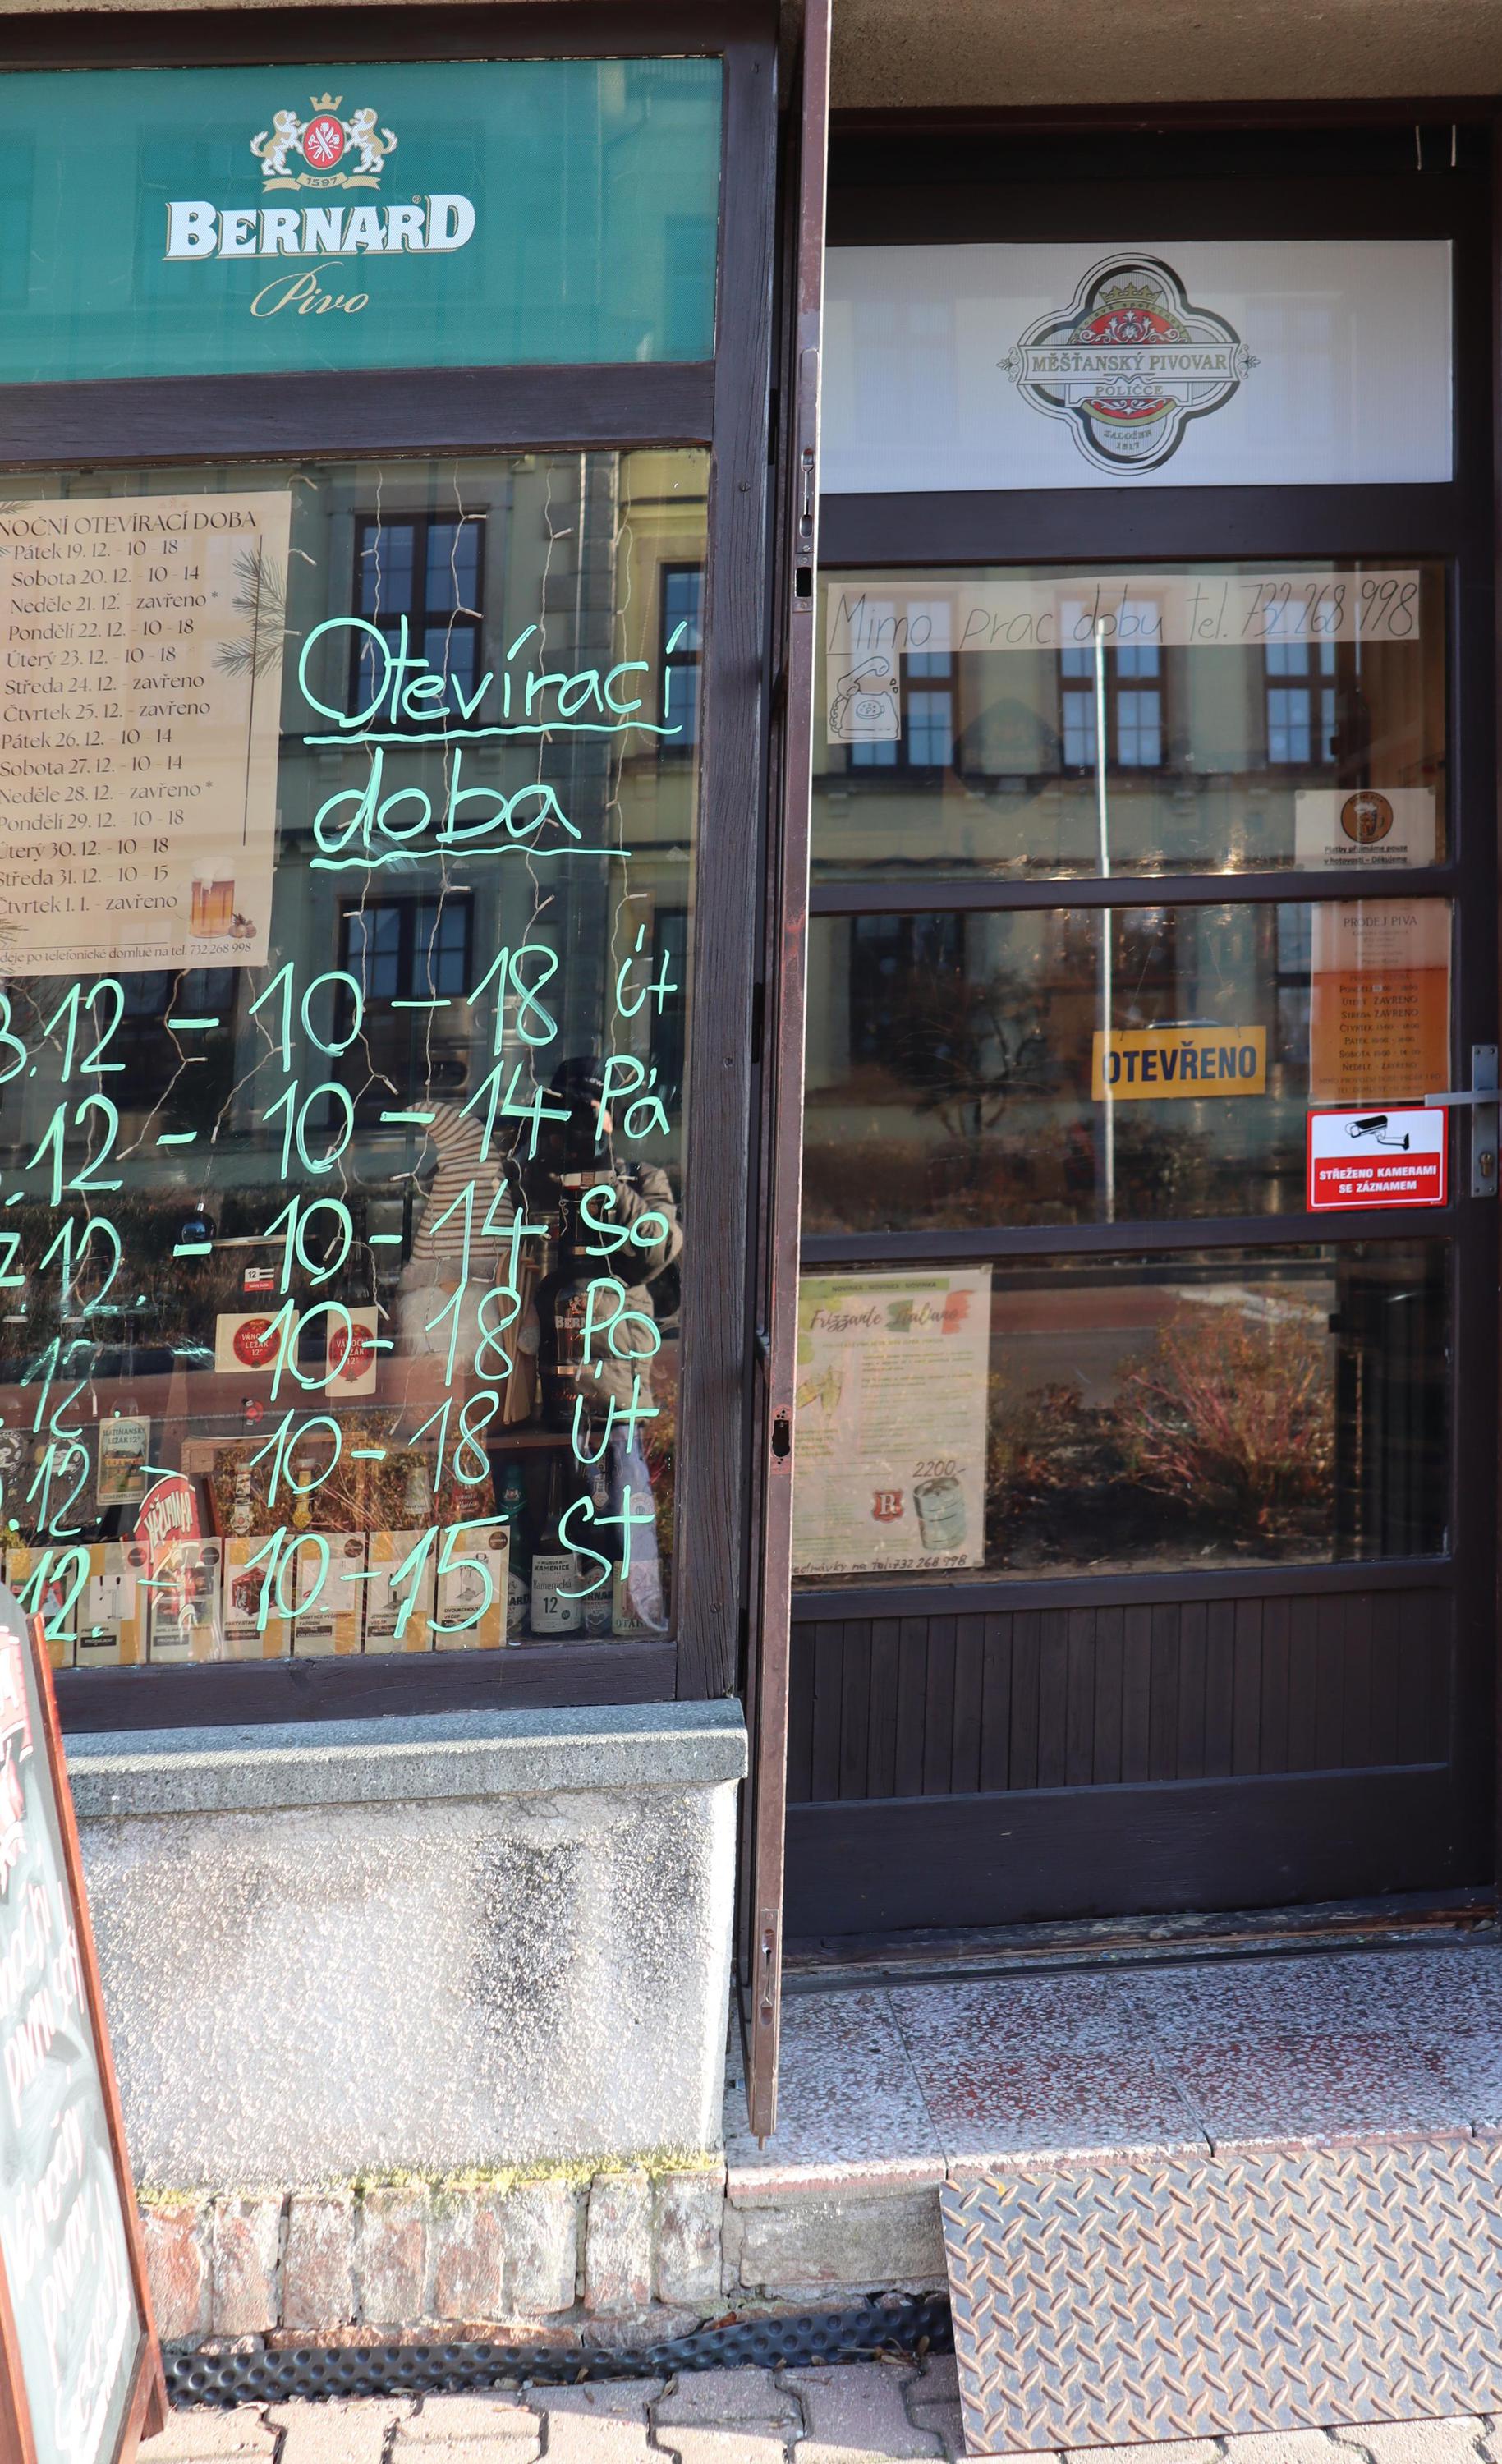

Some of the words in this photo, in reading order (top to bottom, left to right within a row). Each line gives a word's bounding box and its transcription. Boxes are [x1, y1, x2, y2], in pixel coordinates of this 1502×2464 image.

[306, 177, 338, 186] 1597
[163, 194, 475, 260] BERNARD
[250, 261, 369, 317] Pivo
[1032, 352, 1146, 372] MĚŠŤANSKÝ
[1150, 354, 1227, 370] PIVOVAR
[1095, 384, 1163, 395] POLIČCE
[1115, 441, 1141, 450] 1817
[0, 516, 68, 536] NOČNÍ
[75, 511, 188, 534] OTEVÍRACÍ
[194, 511, 256, 529] DOBA
[15, 543, 61, 560] Pátek
[67, 544, 85, 558] 19.
[93, 543, 110, 557] 12.
[129, 540, 146, 555] 10
[163, 540, 177, 554] 18
[12, 570, 75, 586] Sobota
[80, 569, 107, 584] 20.
[113, 568, 131, 582] 12.
[149, 567, 167, 582] 10
[185, 566, 199, 580] 14
[11, 596, 71, 614] Neděle
[76, 597, 95, 611] 21.
[102, 595, 119, 610] 12.
[137, 594, 206, 609] zavřeno
[829, 593, 932, 651] Mimo
[1186, 582, 1228, 641] tel.
[1240, 582, 1292, 637] 732
[1294, 582, 1346, 634] 268
[1359, 579, 1417, 637] 998
[9, 623, 72, 641] Pondělí
[78, 623, 101, 637] 22.
[108, 622, 125, 637] 12.
[144, 621, 162, 635] 10
[179, 619, 194, 633] 18
[7, 650, 56, 669] Úterý
[60, 650, 83, 666] 23.
[90, 650, 108, 664] 12.
[126, 648, 144, 663] 10
[161, 647, 176, 661] 18
[299, 614, 687, 728] Otevírací
[5, 677, 62, 695] Středa
[68, 678, 91, 692] 24.
[99, 676, 116, 691] 12.
[133, 674, 204, 689] zavřeno
[4, 703, 70, 722] Čtvrtek
[76, 704, 98, 719] 25.
[104, 703, 122, 718] 12.
[140, 701, 210, 716] zavřeno
[2, 732, 50, 749] Pátek
[55, 733, 79, 747] 26.
[85, 731, 103, 746] 12.
[122, 729, 140, 744] 10
[158, 729, 171, 742] 14
[0, 760, 63, 776] Sobota
[68, 759, 90, 774] 27.
[97, 757, 114, 772] 12.
[133, 756, 150, 771] 10
[168, 756, 182, 770] 14
[0, 786, 60, 803] Neděle
[65, 786, 88, 802] 28.
[95, 785, 113, 800] 12.
[130, 783, 200, 798] zavřeno
[314, 747, 581, 852] doba
[0, 813, 63, 831] Pondělí
[67, 814, 91, 829] 29.
[98, 812, 116, 828] 12.
[134, 811, 152, 826] 10
[169, 809, 184, 825] 18
[52, 842, 76, 857] 30.
[82, 841, 100, 856] 12.
[119, 839, 136, 854] 10
[154, 838, 168, 853] 18
[0, 869, 53, 886] Středa
[58, 869, 76, 885] 31.
[83, 868, 101, 883] 12.
[119, 867, 137, 881] 10
[155, 865, 168, 880] 15
[67, 898, 75, 912] 1.
[81, 897, 89, 911] 1.
[106, 894, 177, 910] zavřeno
[1344, 917, 1386, 927] PRODEJ
[1392, 916, 1417, 926] PIVA
[26, 954, 42, 965] po
[45, 948, 106, 961] telefonické
[154, 948, 168, 956] na
[172, 945, 187, 955] tel.
[191, 945, 207, 955] 732
[209, 944, 229, 954] 268
[232, 943, 251, 953] 998
[249, 962, 364, 1073] 10
[467, 945, 558, 1055] 18
[1102, 1041, 1257, 1084] OTEVŘENO
[262, 1080, 354, 1179] 10
[459, 1060, 572, 1162] 14
[595, 1055, 670, 1141] Pá
[1319, 1167, 1373, 1180] STŘEŽENO
[1377, 1165, 1436, 1177] KAMERAMI
[1339, 1184, 1353, 1193] SE
[1356, 1180, 1417, 1193] ZÁZNAMEM
[264, 1194, 353, 1294] 10
[429, 1179, 549, 1292] 14
[581, 1185, 669, 1256] So
[247, 1271, 257, 1279] 12
[905, 1281, 937, 1289] NOVINKA
[810, 1305, 884, 1332] Frizzante
[425, 1281, 521, 1386] 18
[580, 1276, 662, 1364] Po
[408, 1390, 500, 1492] 18
[556, 1484, 655, 1598] St
[916, 1557, 939, 1569] 268
[944, 1554, 967, 1567] 998
[533, 1579, 572, 1591] Kamenická
[544, 1597, 558, 1614] 12
